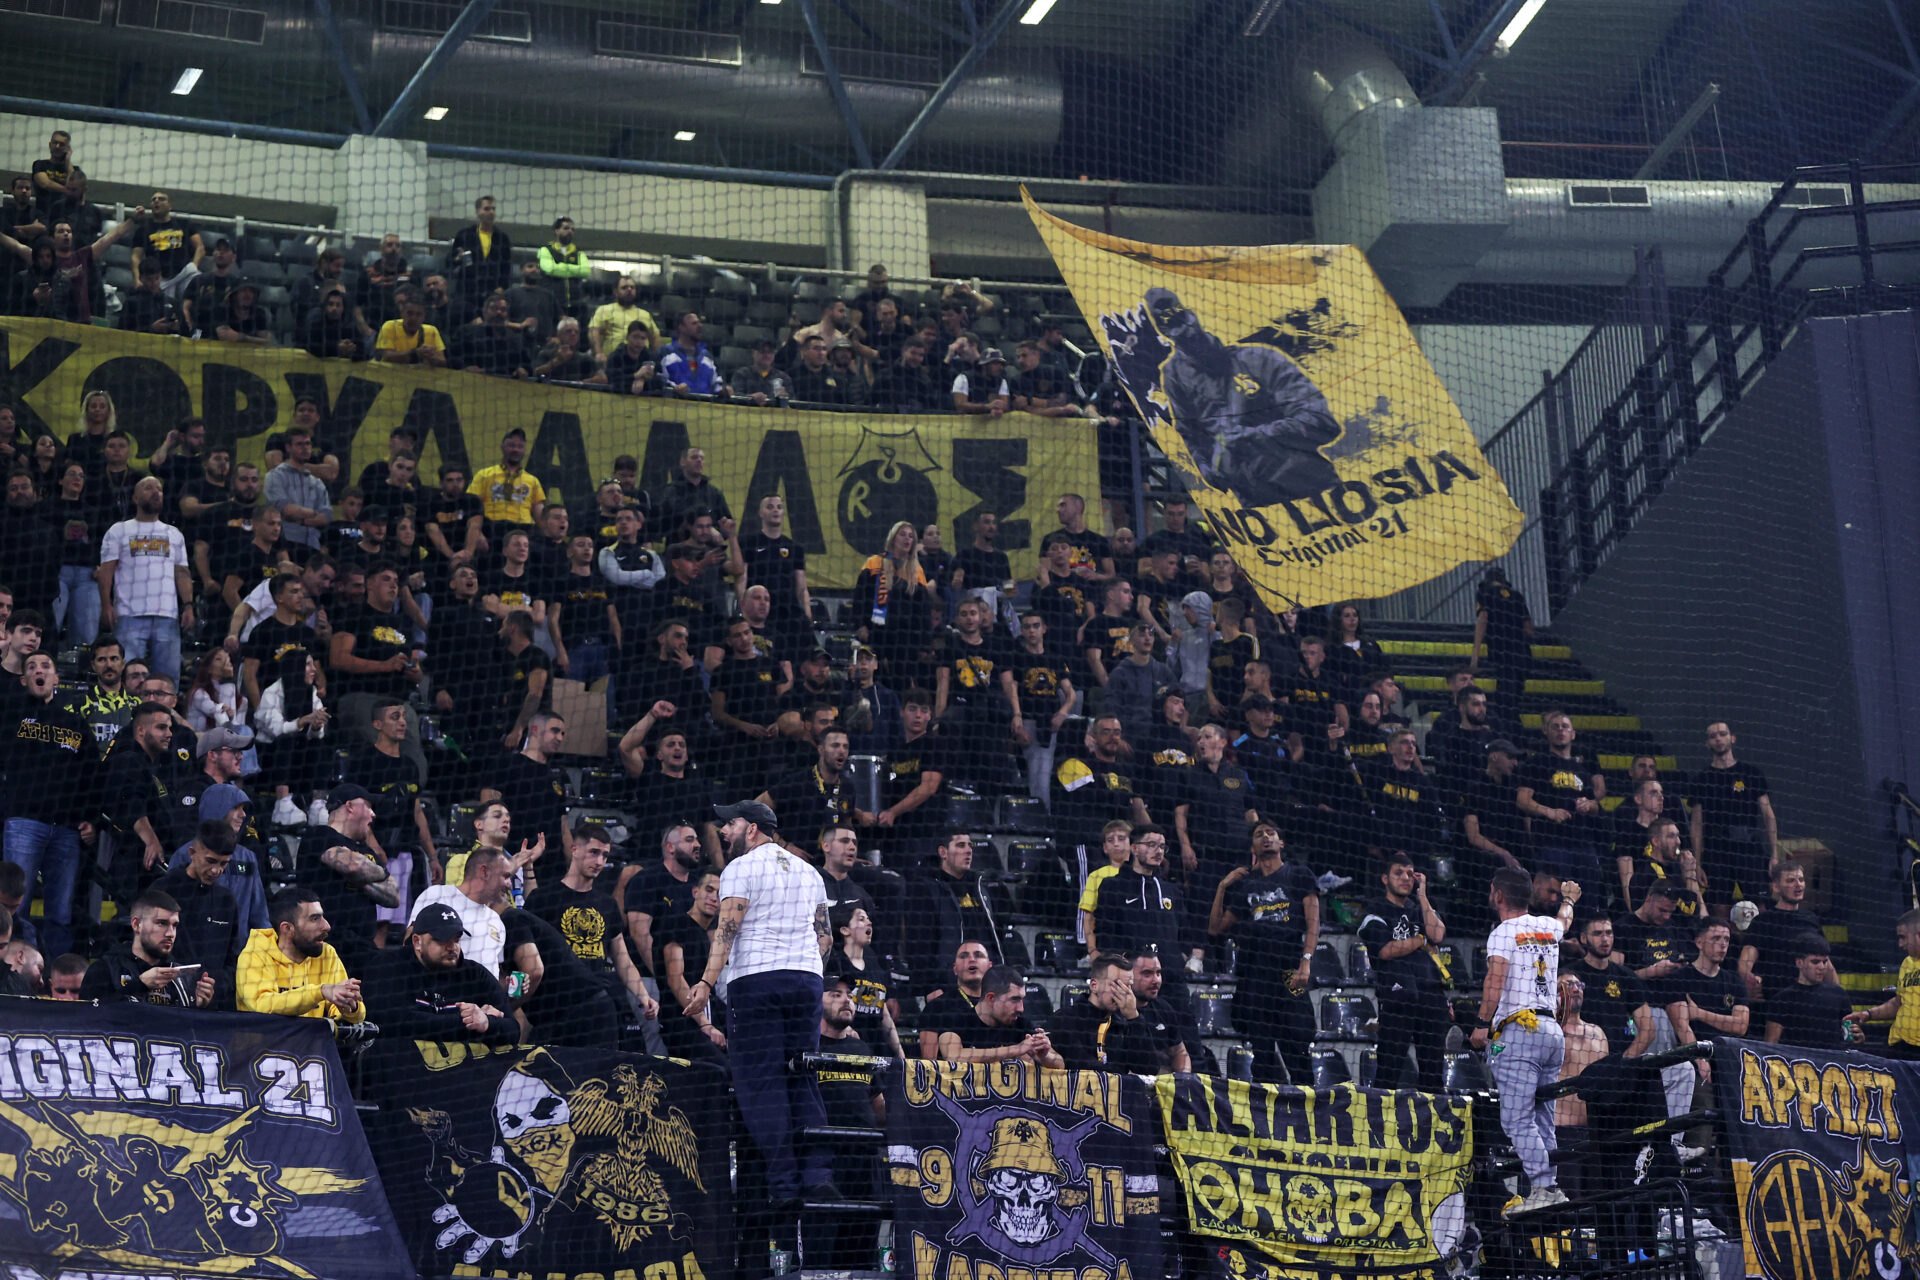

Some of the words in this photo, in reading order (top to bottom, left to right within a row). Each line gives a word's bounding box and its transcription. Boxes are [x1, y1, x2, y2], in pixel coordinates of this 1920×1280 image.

[1369, 509, 1412, 539] 21
[256, 1054, 335, 1123] 21
[902, 1057, 1132, 1136] ORIGINAL
[1170, 1073, 1466, 1154] ALIARTOS
[580, 1179, 669, 1224] 1986
